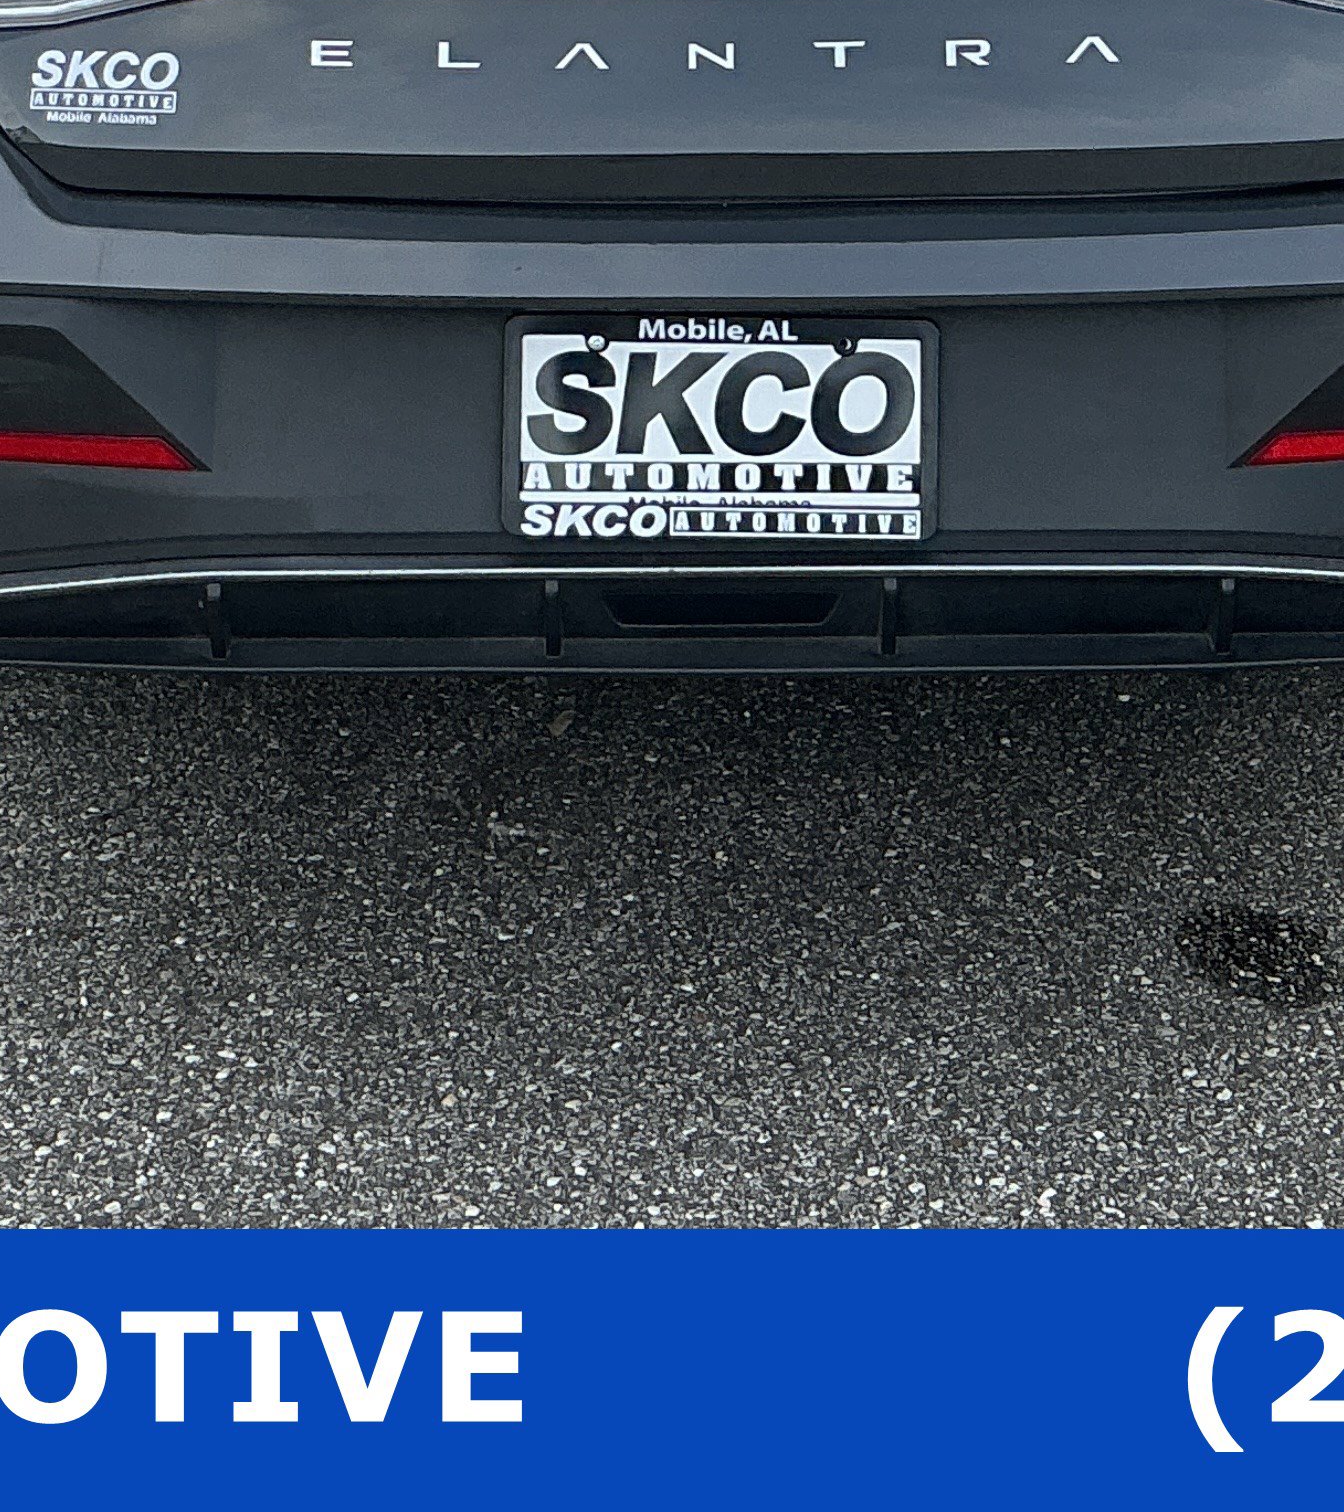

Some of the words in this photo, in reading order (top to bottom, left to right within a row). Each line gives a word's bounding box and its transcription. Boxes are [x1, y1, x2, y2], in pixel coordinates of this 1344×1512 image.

[310, 35, 1120, 71] ELANTRA
[31, 49, 180, 90] SKCO
[33, 91, 174, 110] AUTOMOTIVE
[46, 111, 93, 125] Mobile
[97, 112, 158, 126] Alabama
[638, 318, 752, 344] Mobile,
[757, 320, 799, 341] AL
[526, 350, 916, 457] SKCO
[523, 462, 913, 491] AUTOMOTIVE
[520, 503, 668, 538] SKCO
[674, 511, 917, 534] AUTOMOTIVE
